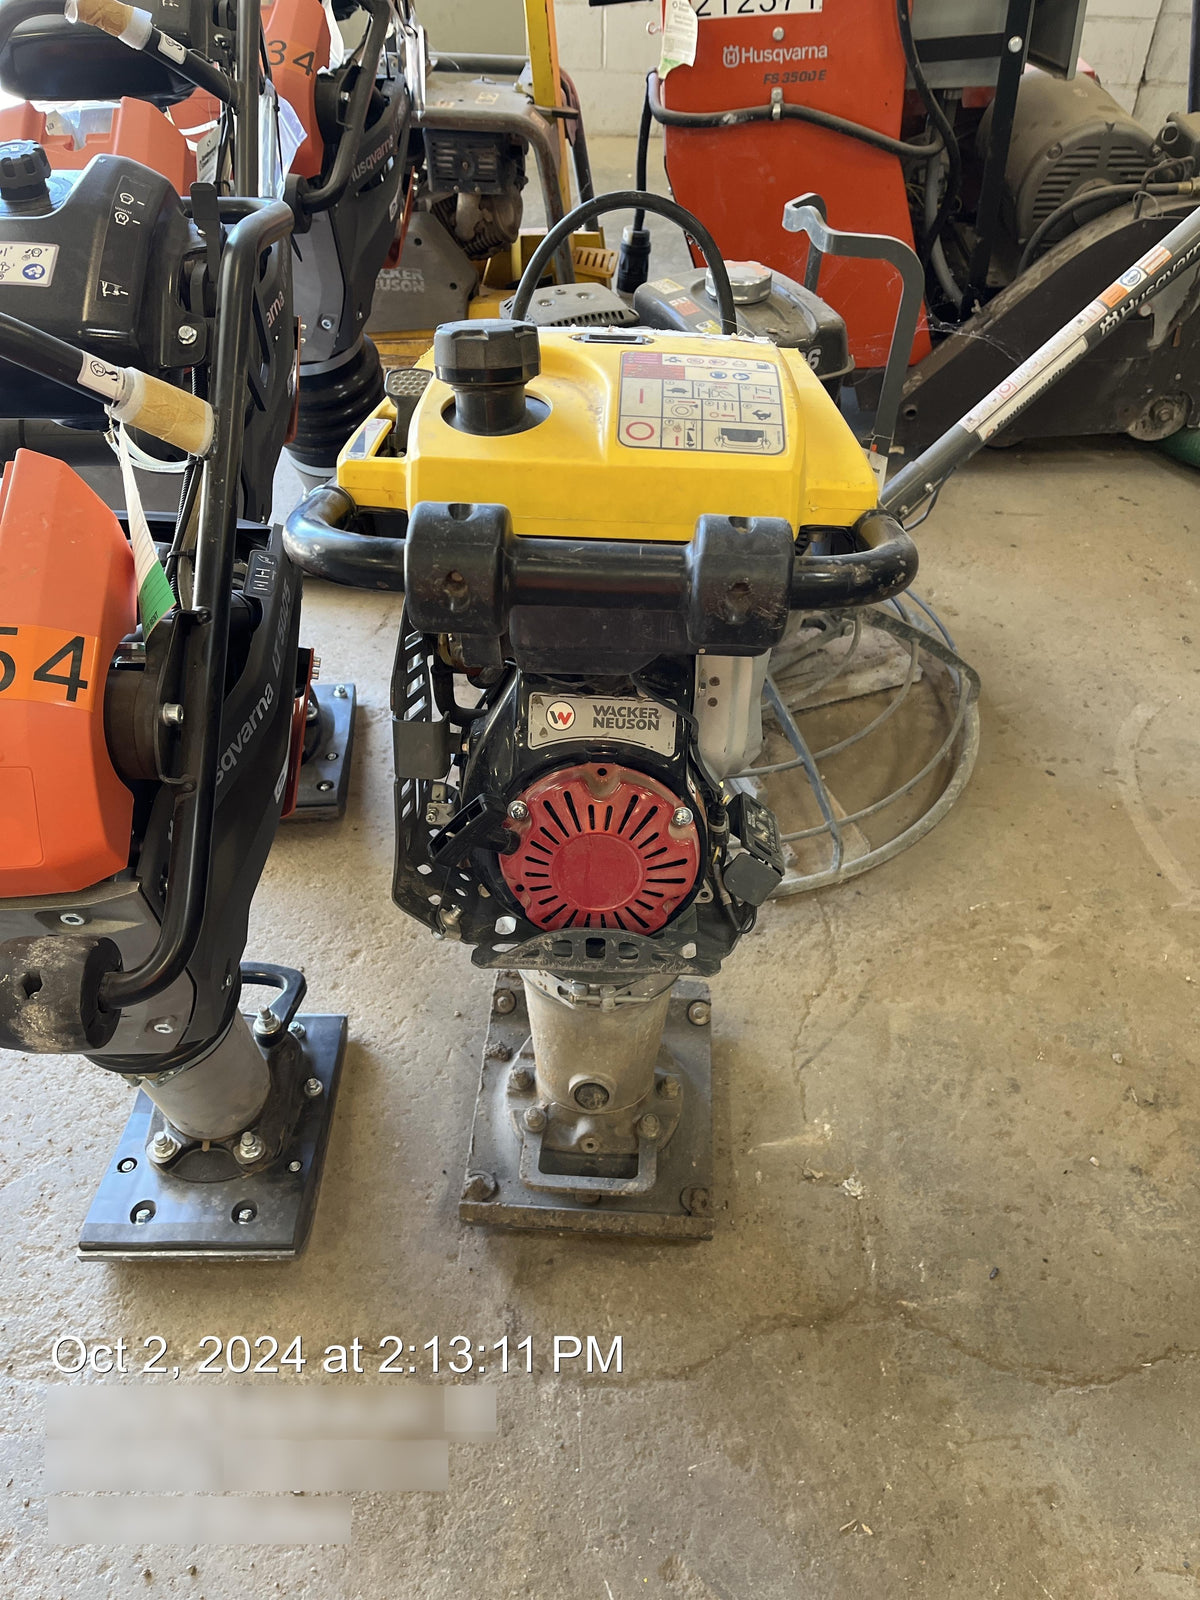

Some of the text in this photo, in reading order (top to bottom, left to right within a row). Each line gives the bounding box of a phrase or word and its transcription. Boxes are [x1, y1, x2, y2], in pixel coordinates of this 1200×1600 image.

[267, 39, 316, 76] 34
[741, 44, 828, 64] Husqvarna
[763, 72, 780, 84] FS
[0, 626, 89, 702] 54
[592, 704, 660, 719] WACKER
[592, 716, 660, 731] NEUSON
[215, 682, 274, 786] sqvarna
